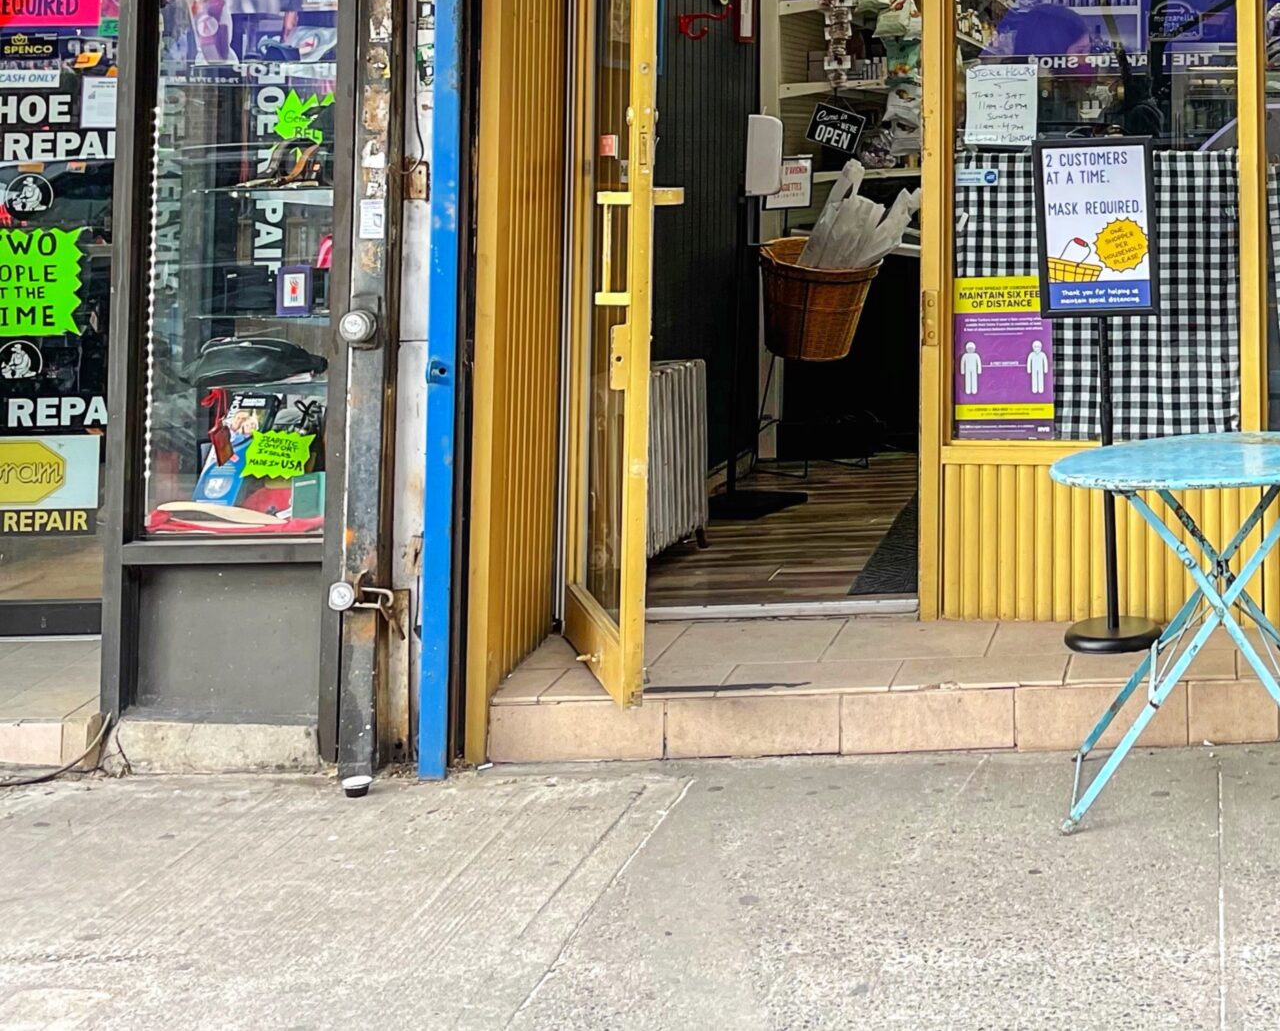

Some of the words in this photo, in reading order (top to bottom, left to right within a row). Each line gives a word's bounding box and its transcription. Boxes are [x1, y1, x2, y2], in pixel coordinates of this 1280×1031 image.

[3, 45, 53, 54] SPENCO
[0, 74, 26, 83] CASH
[28, 73, 57, 83] ONLY
[0, 94, 71, 124] HOE
[815, 124, 851, 150] OPEN
[1045, 154, 1053, 168] 2
[1059, 151, 1128, 167] CUSTOMERS
[1046, 171, 1060, 185] AT
[1066, 171, 1074, 185] A
[1080, 169, 1110, 184] TIME.
[1048, 202, 1079, 216] MASK
[1086, 199, 1143, 215] REQUIRED.
[0, 232, 57, 256] WO
[1105, 231, 1135, 245] SHOPPER
[1113, 253, 1139, 266] PLEASE
[14, 286, 45, 299] THE
[959, 291, 1004, 300] MAINTAIN
[1007, 291, 1021, 299] SIX
[971, 300, 983, 308] OF
[987, 299, 1032, 308] DISTANCE
[7, 395, 108, 428] REPA
[0, 462, 63, 485] ram
[281, 459, 303, 472] USA
[3, 510, 88, 532] REPAIR
